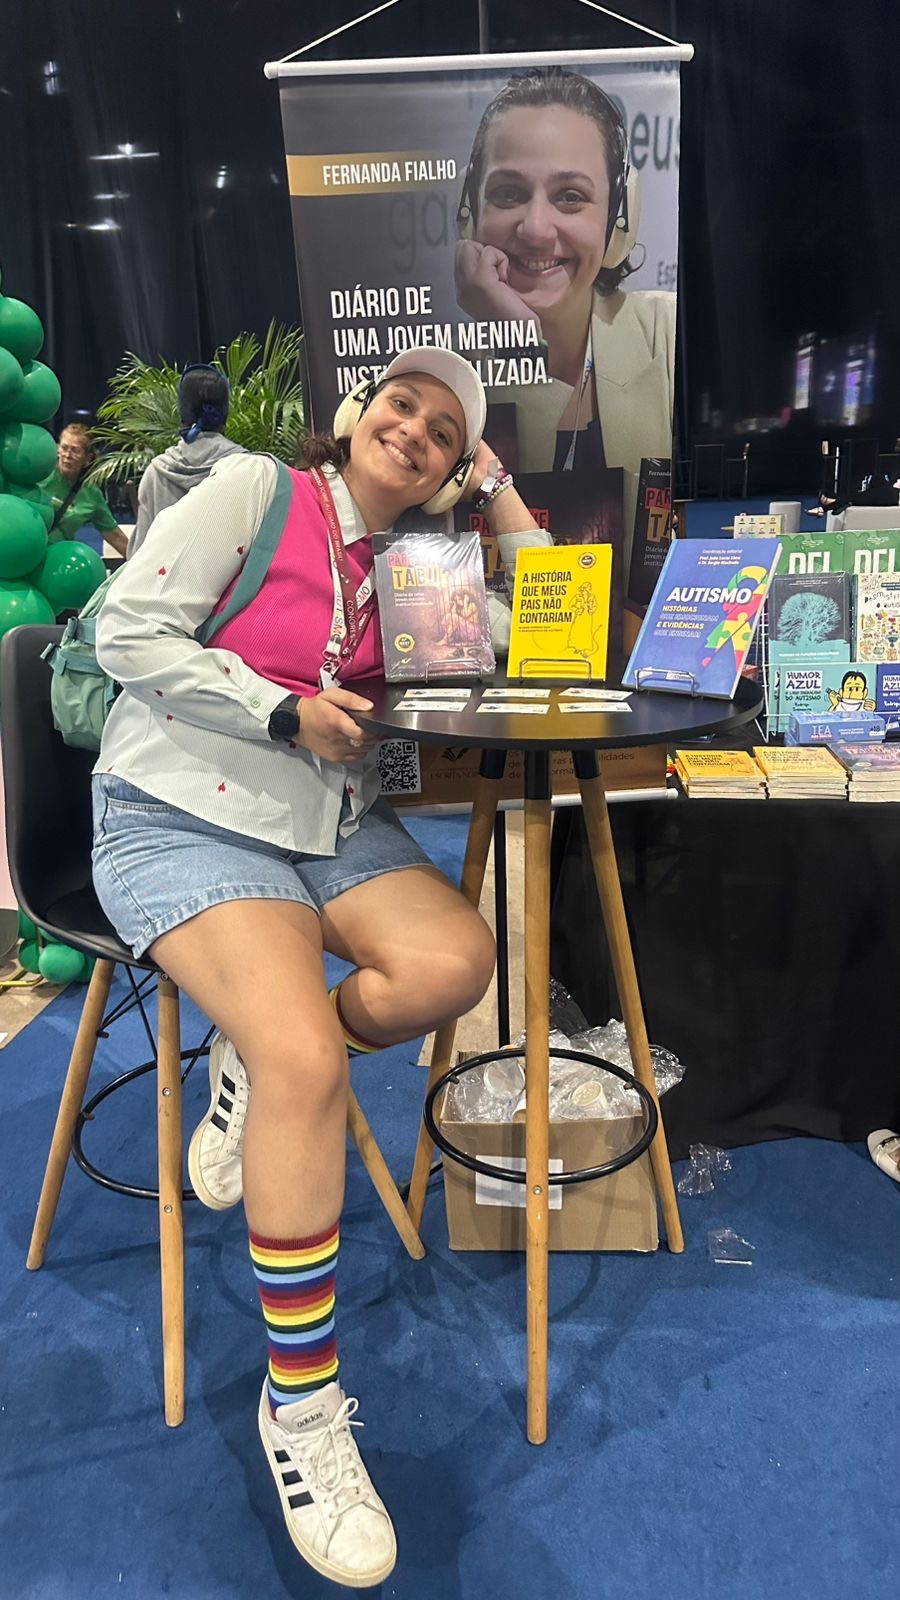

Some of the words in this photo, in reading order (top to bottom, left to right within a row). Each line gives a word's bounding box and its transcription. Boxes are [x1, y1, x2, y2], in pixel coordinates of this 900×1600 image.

[322, 164, 401, 186] FERNANDA
[404, 159, 457, 181] FIALHO
[330, 284, 400, 319] DIÁRIO
[405, 286, 433, 315] DE
[333, 327, 381, 357] UMA
[386, 323, 452, 354] JOVEM
[458, 319, 539, 350] MENINA
[522, 573, 529, 583] A
[531, 569, 572, 583] HISTÓRIA
[522, 585, 539, 597] QUE
[541, 585, 567, 596] MEUS
[666, 587, 752, 603] AUTISMO
[520, 599, 541, 610] PAIS
[543, 597, 562, 609] NÃO
[519, 612, 572, 624] CONTARIAM
[663, 620, 704, 629] EVIDÊNCIAS
[786, 671, 821, 679] HUMOR
[785, 680, 821, 689] AZUL
[812, 725, 831, 735] TEA
[297, 1412, 324, 1427] adidas
